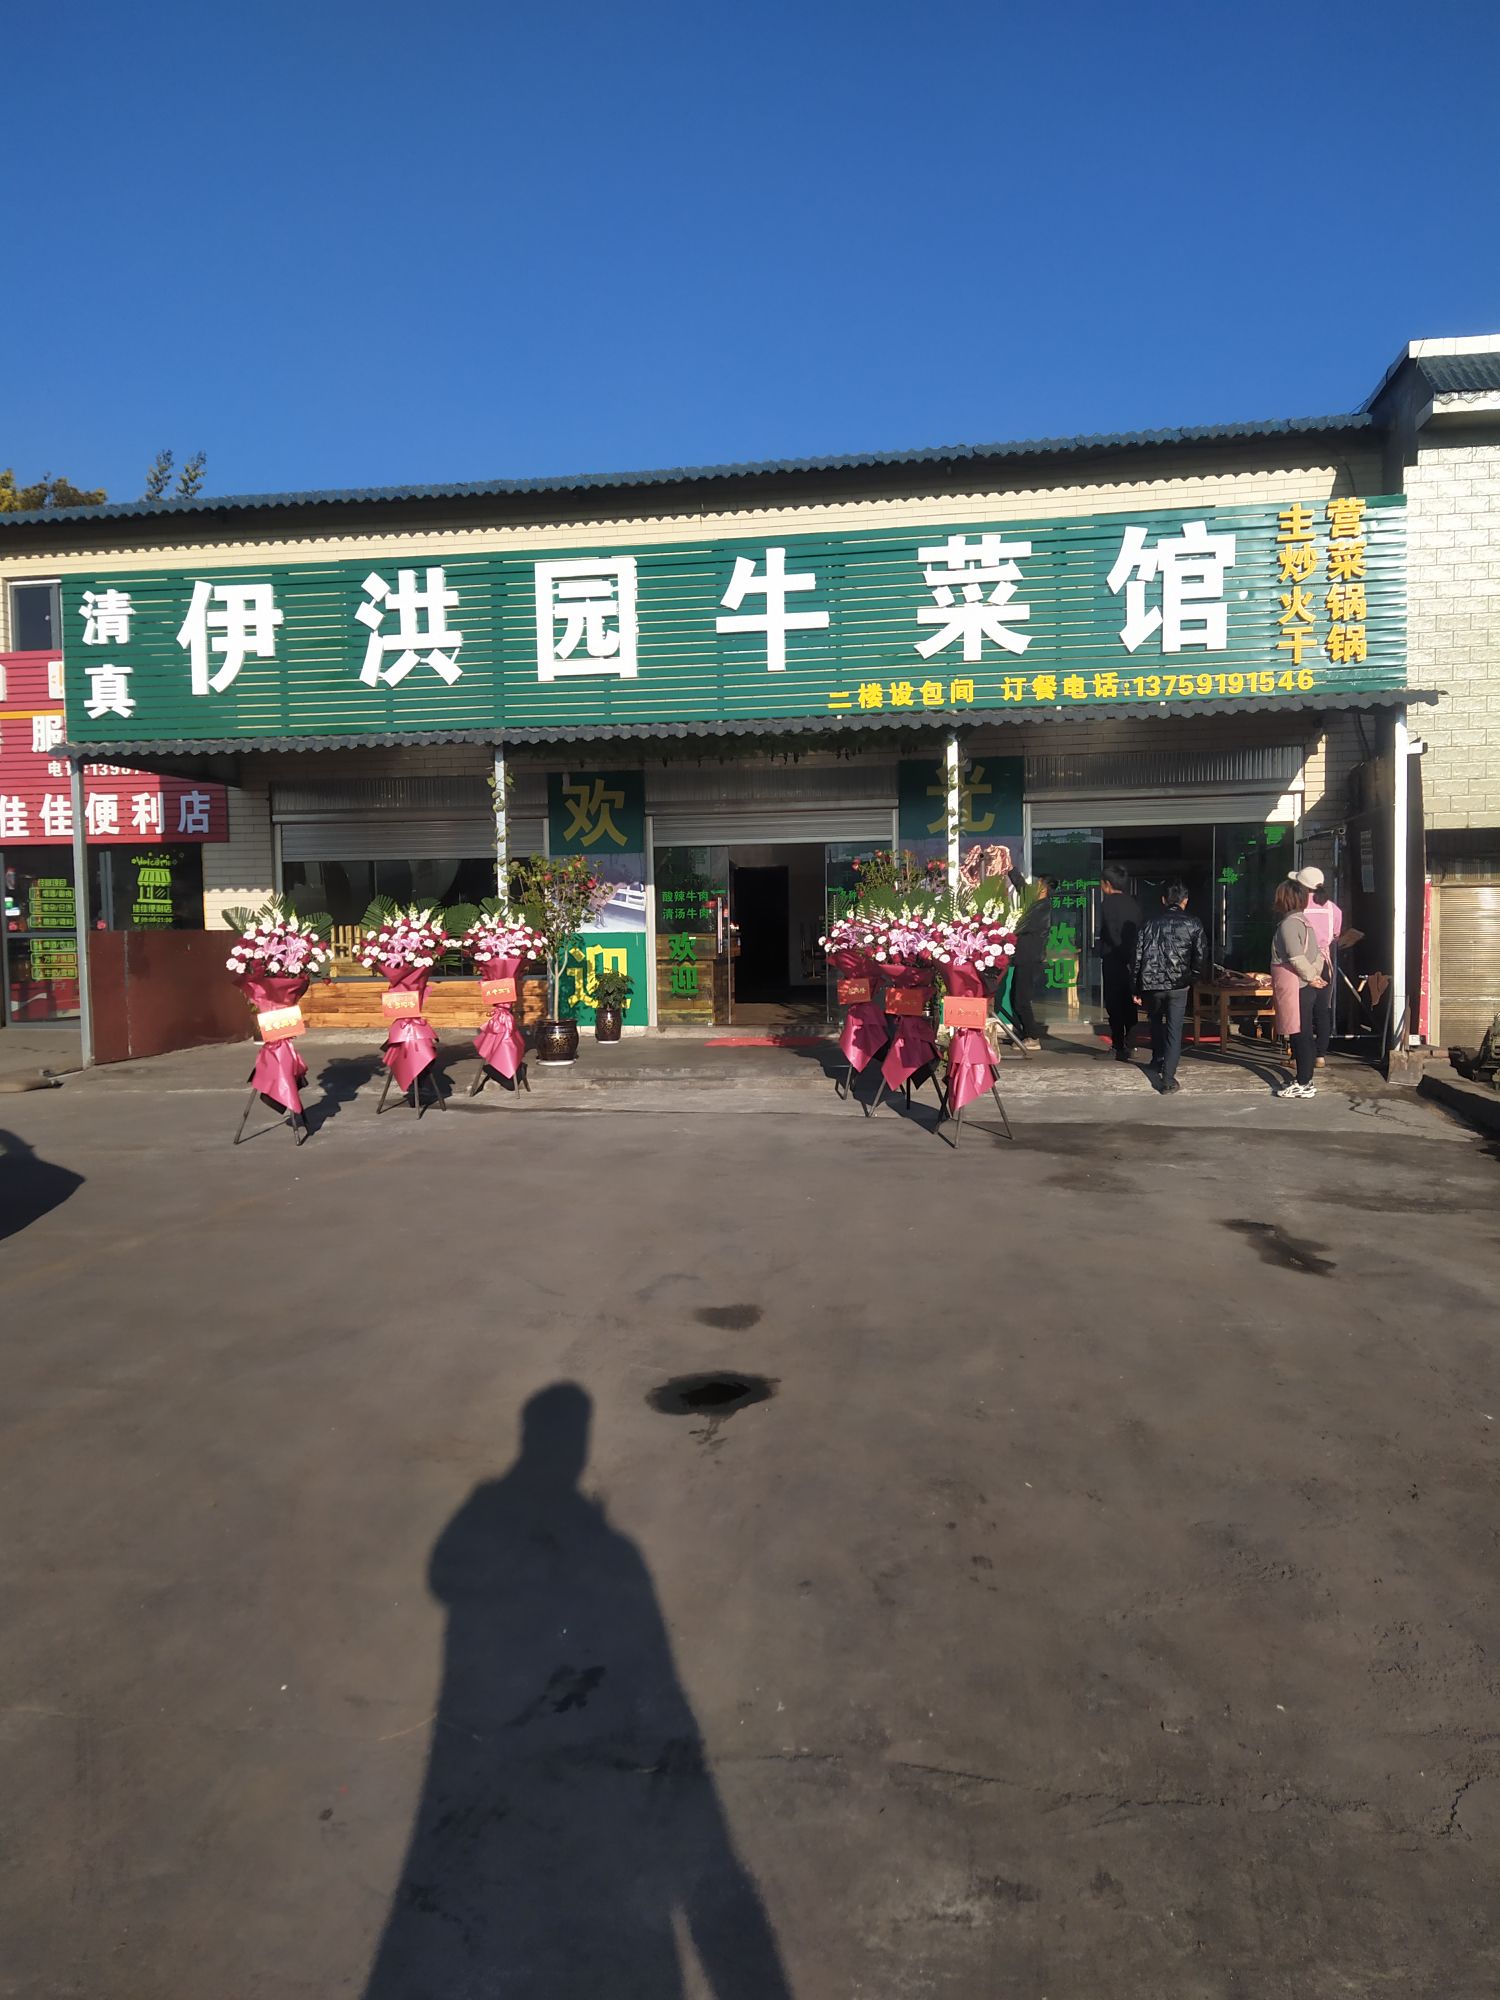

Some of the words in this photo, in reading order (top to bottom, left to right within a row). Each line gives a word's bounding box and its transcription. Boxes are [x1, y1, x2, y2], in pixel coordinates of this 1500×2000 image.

[1277, 497, 1367, 541] 主营
[1278, 541, 1368, 583] 炒菜
[176, 520, 1236, 696] 伊洪园牛菜馆
[1278, 583, 1367, 625] 火锅
[78, 588, 136, 720] 清真
[1277, 624, 1368, 664] 干锅
[828, 678, 975, 709] 二楼设包间
[561, 778, 628, 847] 欢
[662, 889, 709, 902] 酸辣牛肉
[663, 908, 709, 919] 清汤牛肉
[668, 932, 699, 993] 欢迎
[1045, 922, 1078, 988] 欢迎
